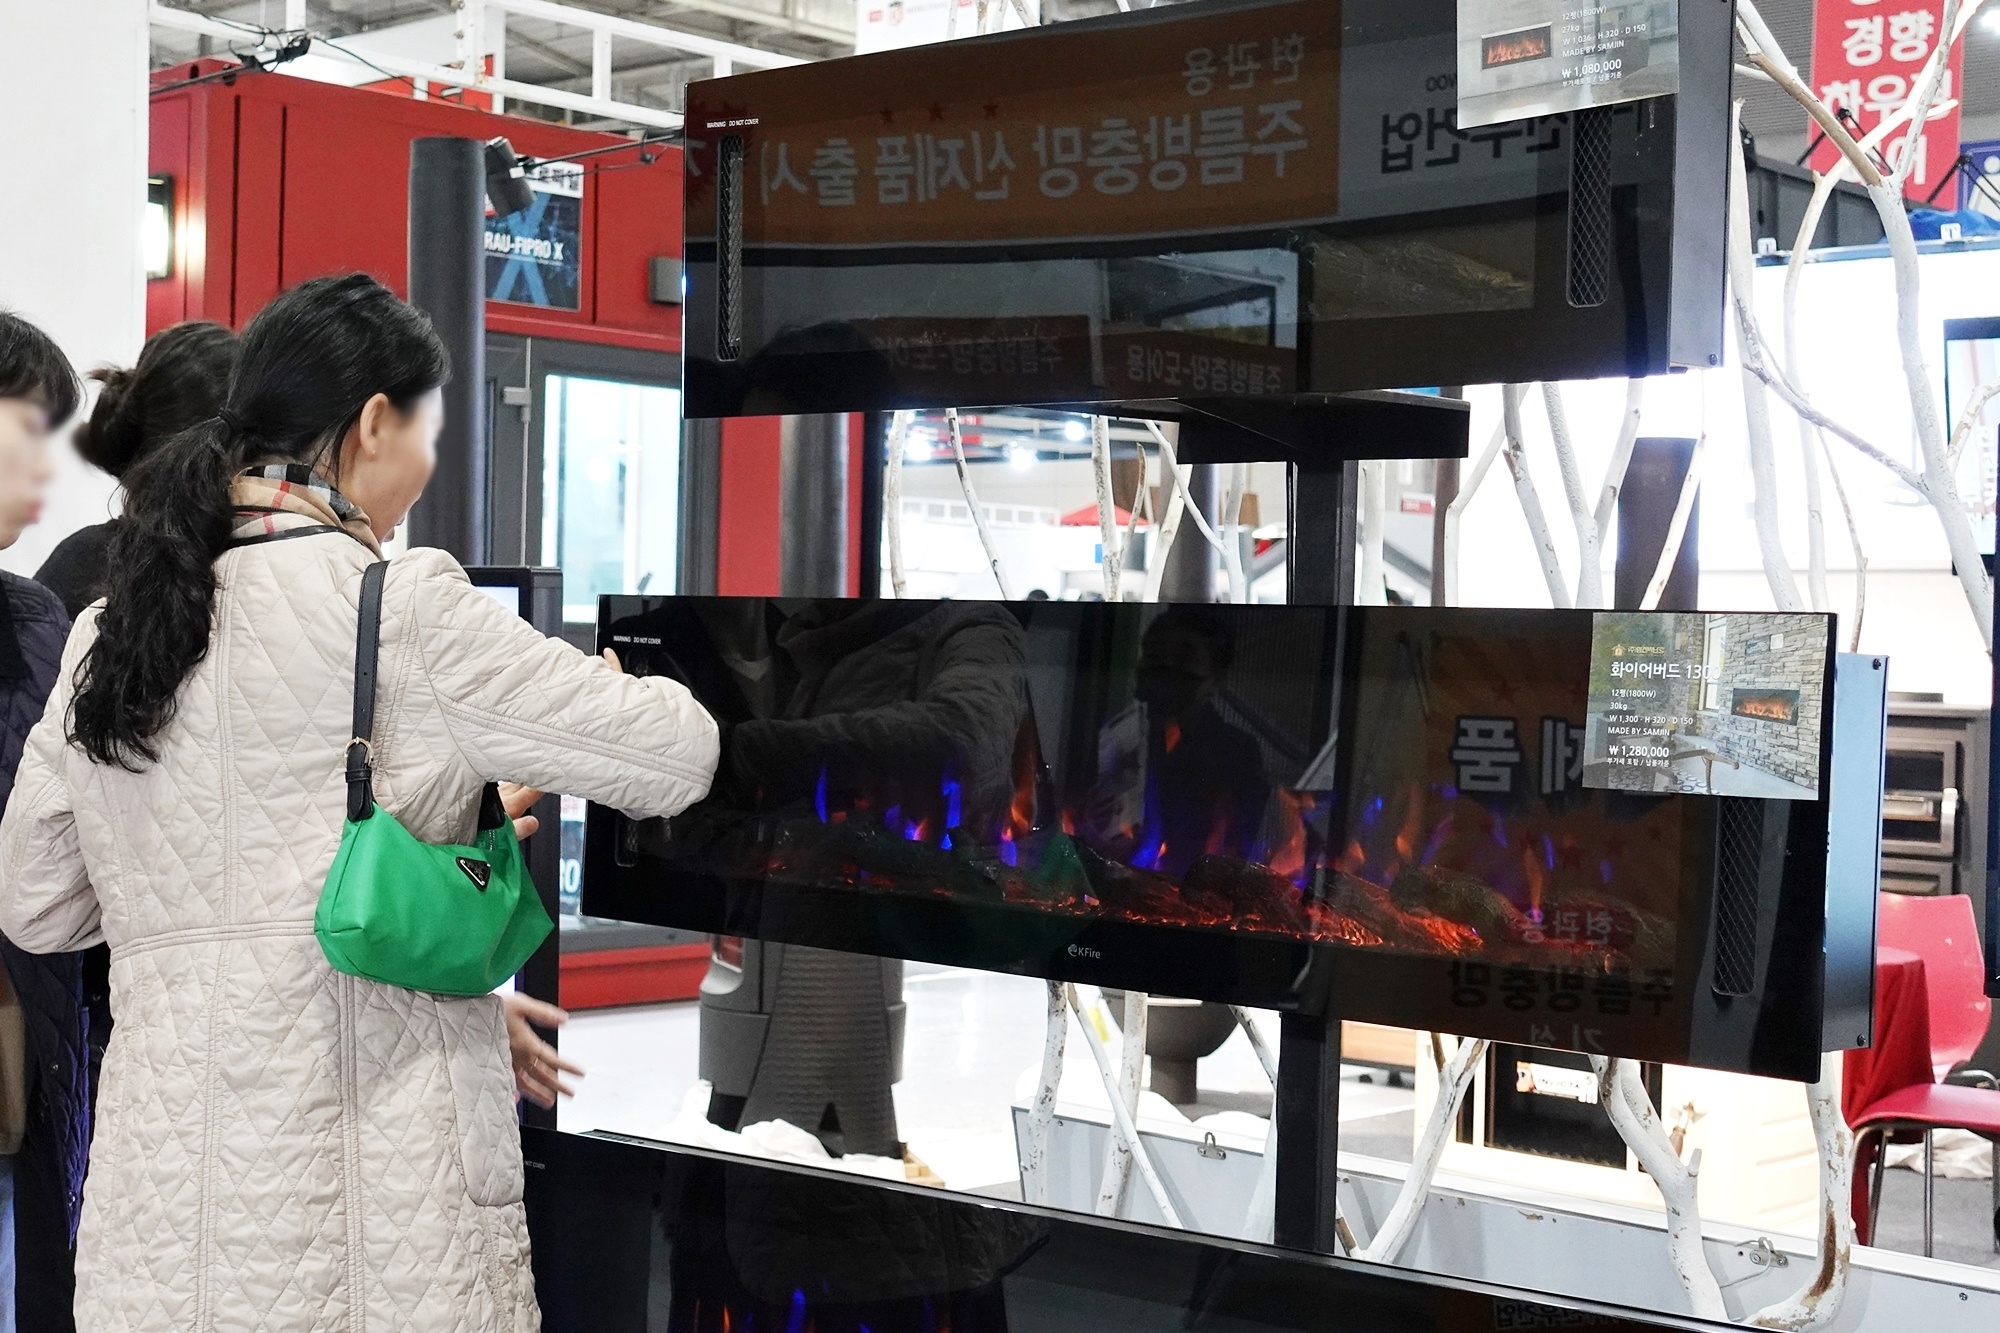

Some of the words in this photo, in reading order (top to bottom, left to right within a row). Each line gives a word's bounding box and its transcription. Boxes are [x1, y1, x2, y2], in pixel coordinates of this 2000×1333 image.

[1562, 25, 1580, 34] 27kg
[1562, 38, 1571, 46] W
[1573, 34, 1592, 44] 1,036
[1597, 32, 1604, 40] H
[1606, 29, 1619, 38] 320
[1625, 27, 1631, 35] D
[1633, 24, 1647, 33] 150
[1842, 9, 1935, 67] 경향
[1562, 47, 1584, 58] MADE
[1586, 45, 1596, 54] BY
[1597, 40, 1625, 52] SAMJIN
[1574, 59, 1622, 77] 1,080,000
[744, 118, 759, 126] COVER
[484, 231, 552, 260] RAU-FIPRO
[553, 241, 564, 261] X
[648, 637, 661, 645] COVER
[1610, 661, 1682, 680] 화이어버드
[1685, 664, 1721, 680] 1300
[1610, 702, 1628, 711] 30kg
[1609, 715, 1618, 723] W
[1619, 715, 1639, 724] 1,300
[1652, 716, 1666, 724] 320
[1680, 717, 1693, 725] 150
[1607, 727, 1630, 735] MADE
[1631, 727, 1642, 735] BY
[1643, 728, 1670, 737] SAMJIN
[1608, 745, 1619, 756] ₩
[1621, 745, 1670, 758] 1,280,000
